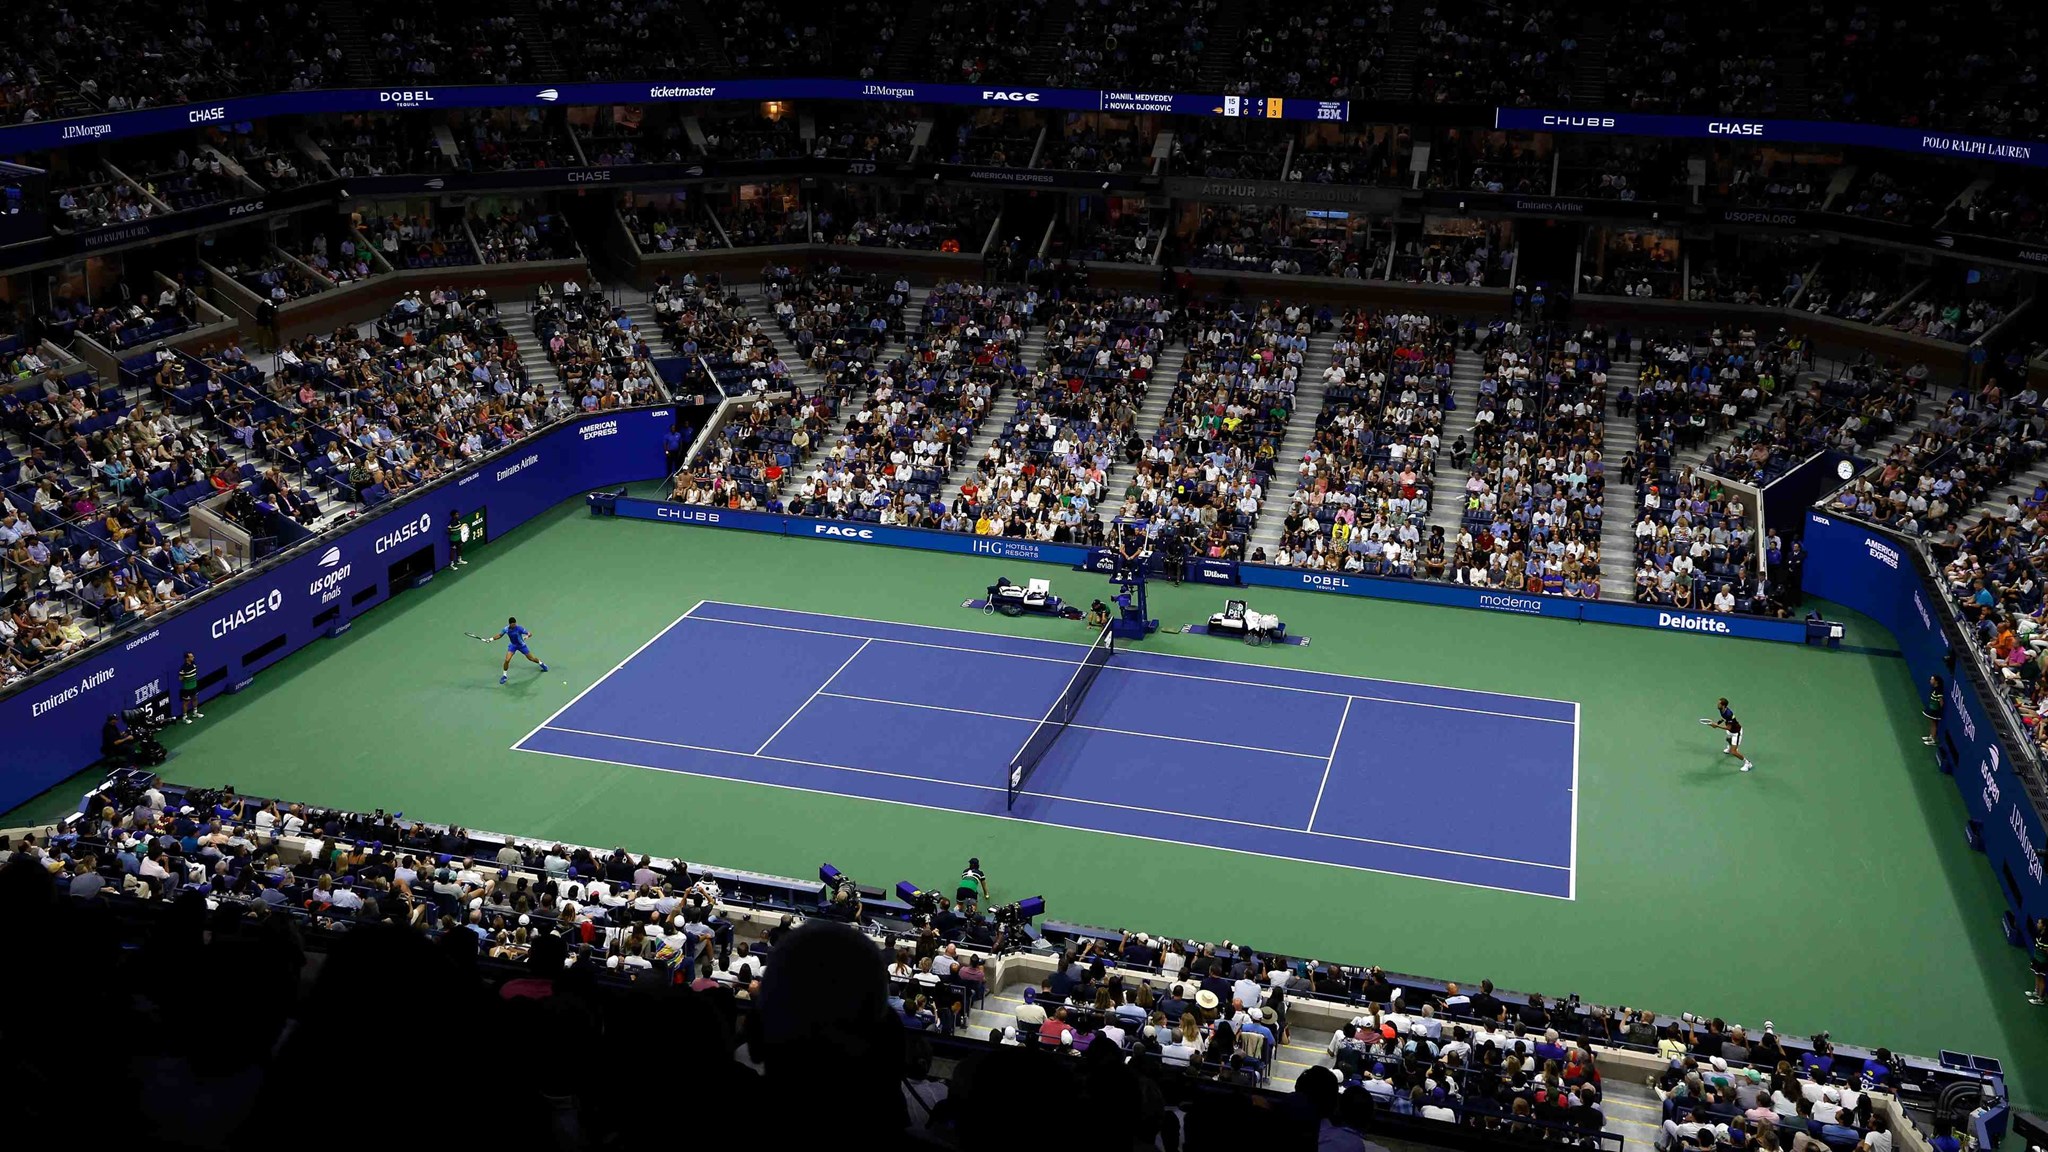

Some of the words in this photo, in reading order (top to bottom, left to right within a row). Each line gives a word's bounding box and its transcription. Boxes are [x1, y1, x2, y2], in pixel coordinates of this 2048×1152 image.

[380, 91, 434, 102] DOBEL
[650, 85, 716, 98] ticketmaster
[862, 85, 914, 98] J.P.Morgan
[982, 91, 1040, 102] FAGE
[1110, 92, 1134, 100] DANIIL
[1135, 94, 1173, 102] MEDVEDEV
[1244, 98, 1249, 106] 3
[1110, 102, 1134, 110] NOVAK
[1136, 104, 1172, 112] DJOKOVIC
[1317, 108, 1342, 120] IBM
[189, 107, 225, 123] CHASE
[1543, 115, 1615, 128] CHUBB
[62, 124, 111, 140] J.P.Morgan
[1708, 122, 1764, 136] CHASE
[1922, 136, 1950, 150] POLO
[1952, 138, 1986, 155] RALPH
[1988, 142, 2031, 160] LAUREN
[568, 170, 610, 182] CHASE
[970, 171, 1014, 180] AMERICAN
[1016, 174, 1054, 183] EXPRESS
[1202, 184, 1256, 198] ARTHUR
[1260, 187, 1295, 200] ASHE
[229, 201, 264, 216] FAGE
[1516, 200, 1552, 211] Emirates
[1554, 201, 1584, 212] Airline
[1724, 210, 1797, 225] USOPEN.ORG
[652, 410, 669, 418] USTA
[579, 420, 617, 435] AMERICAN
[584, 427, 618, 441] EXPRESS
[496, 464, 520, 482] Emirates
[520, 453, 539, 470] Airline
[657, 508, 720, 523] CHUBB
[1812, 515, 1830, 526] USTA
[375, 522, 418, 555] CHASE
[816, 524, 874, 539] FAGE
[972, 539, 1002, 556] IHG
[1005, 550, 1039, 559] RESORTS
[1006, 543, 1032, 551] HOTELS
[1864, 538, 1899, 561] AMERICAN
[1869, 548, 1899, 570] EXPRESS
[309, 578, 324, 596] us
[324, 564, 350, 593] open
[1204, 570, 1229, 580] Wilson
[1303, 574, 1350, 588] DOBEL
[322, 585, 342, 605] finals
[1480, 595, 1541, 610] moderna
[211, 596, 266, 640] CHASE
[1658, 612, 1731, 634] Deloitte.
[126, 629, 160, 651] USOPEN.ORG
[32, 685, 78, 718] Emirates
[80, 666, 115, 693] Airline
[134, 678, 161, 705] IBM
[2009, 802, 2043, 886] J.P.Morgan
